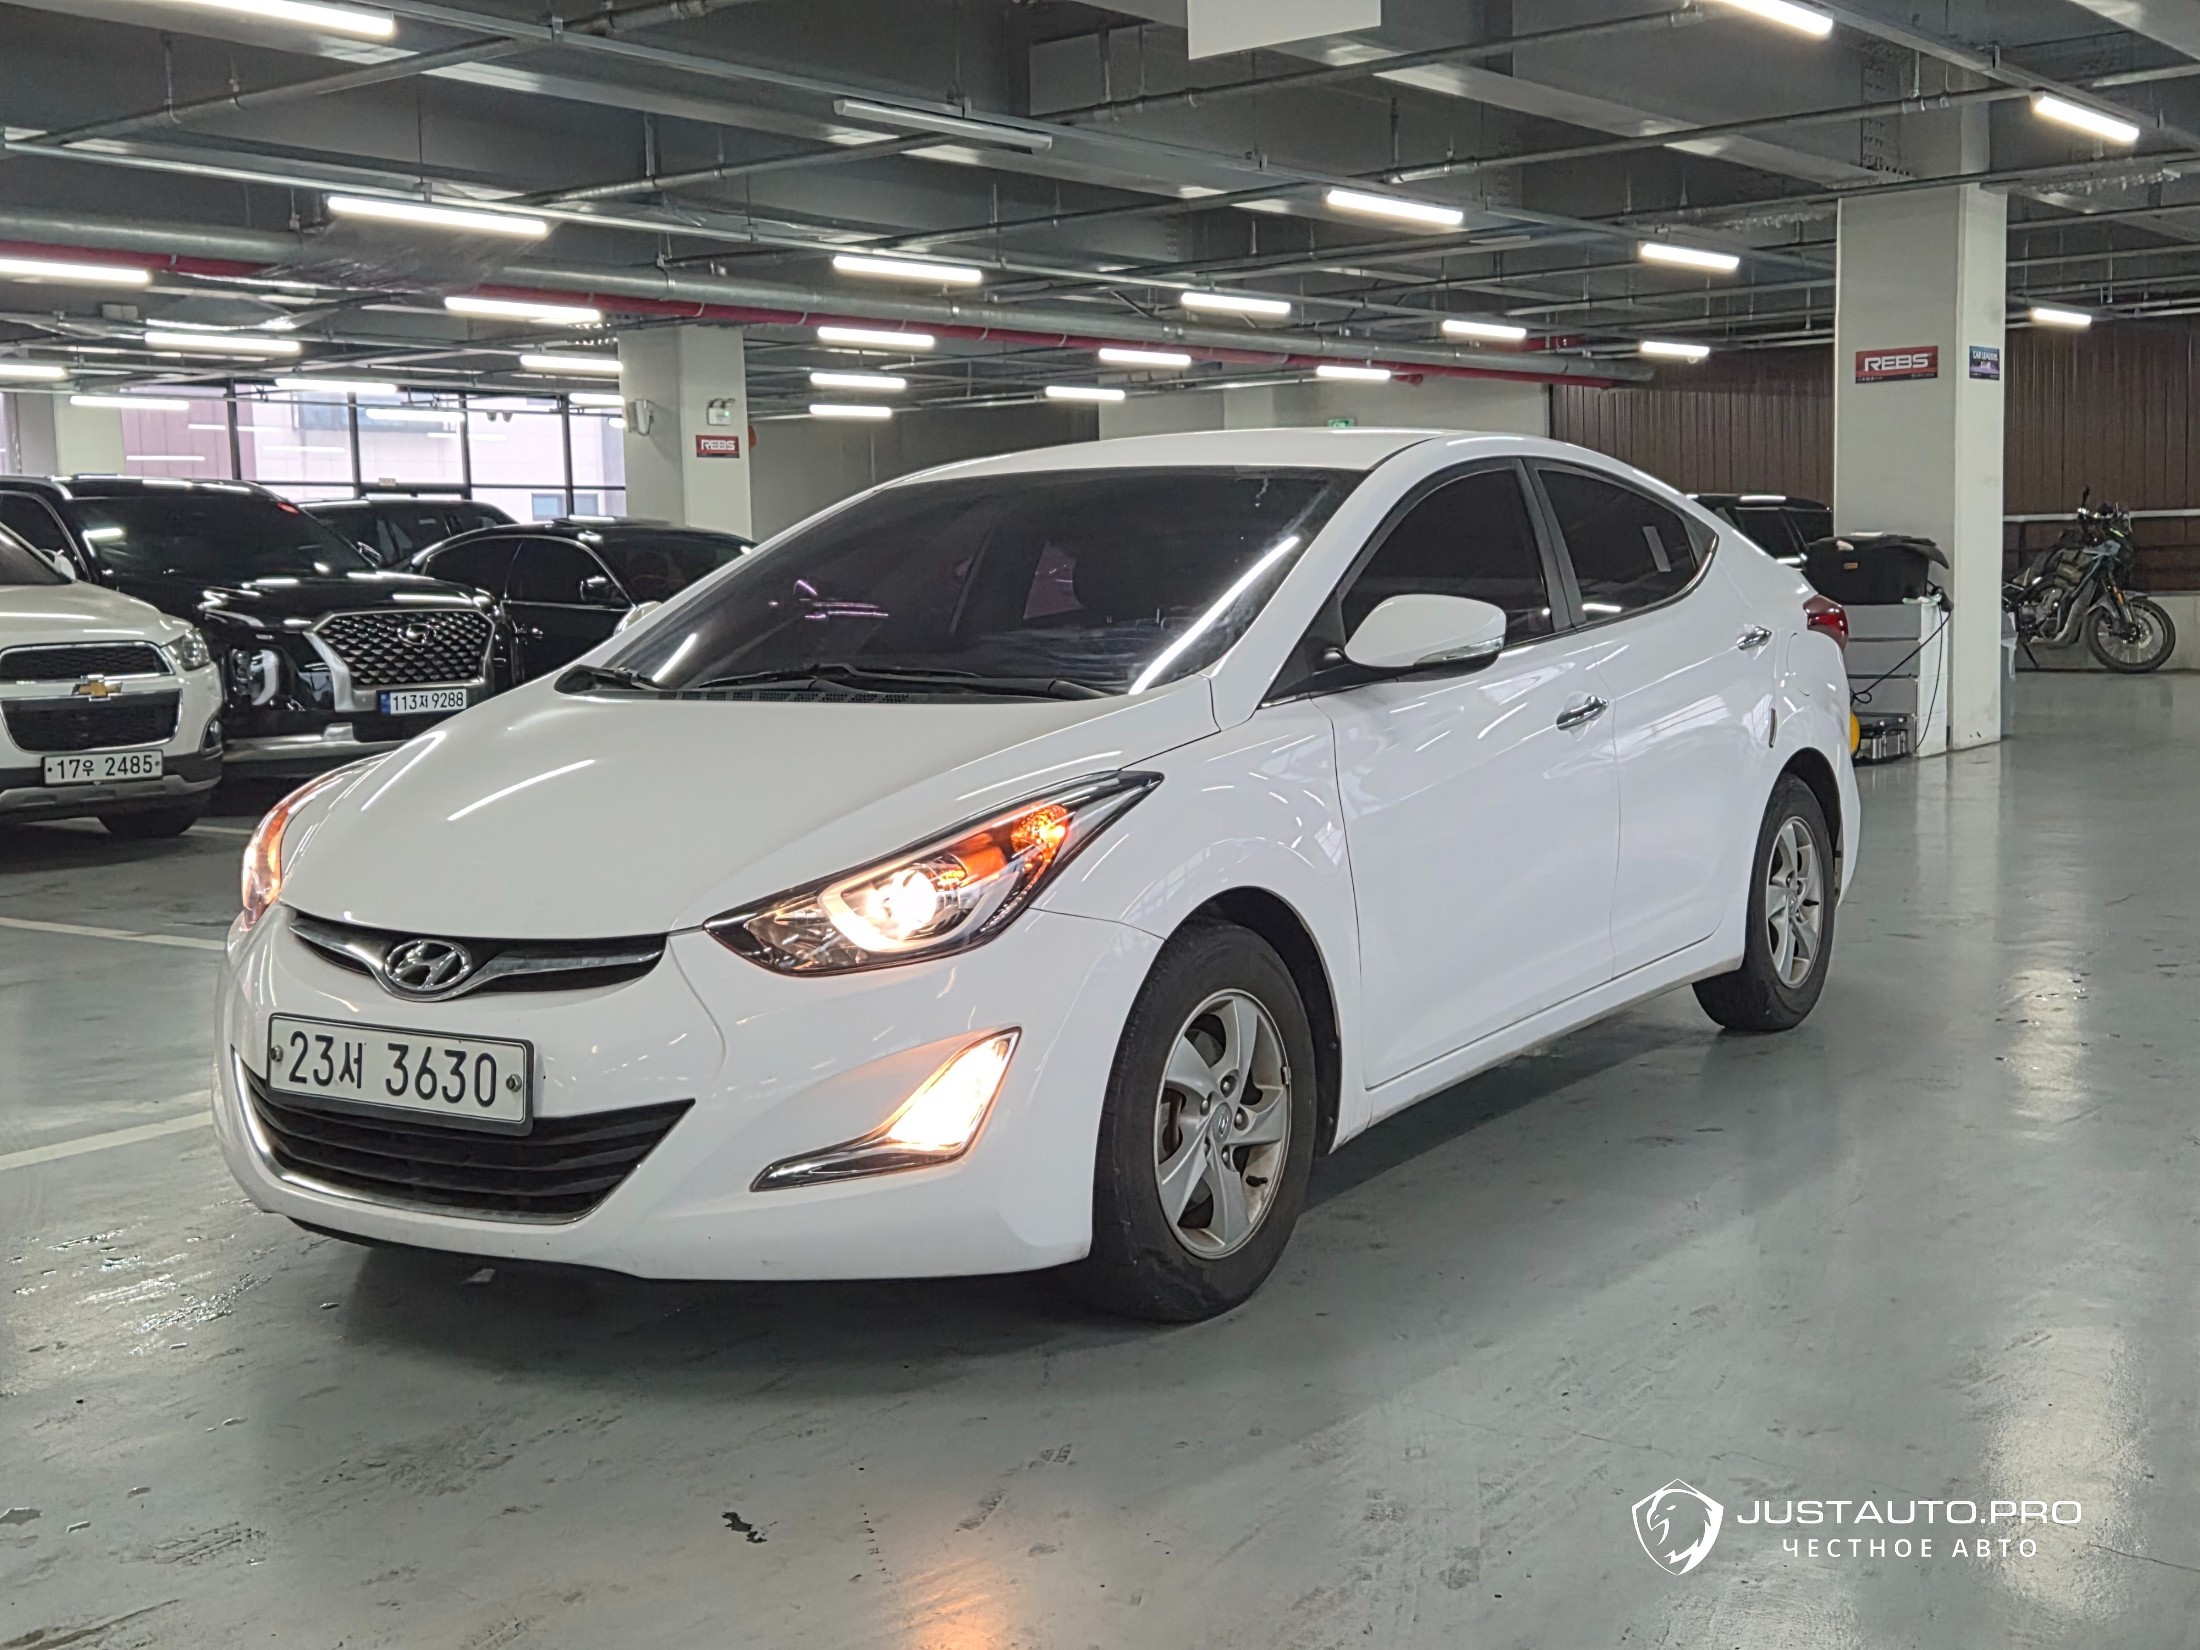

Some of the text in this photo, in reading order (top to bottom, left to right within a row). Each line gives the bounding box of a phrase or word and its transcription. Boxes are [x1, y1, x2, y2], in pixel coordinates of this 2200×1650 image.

[1865, 353, 1929, 372] REBS
[701, 439, 736, 451] REBS
[431, 691, 464, 709] 9288
[57, 755, 152, 779] 17우 2485
[289, 1031, 496, 1107] 23서 3630
